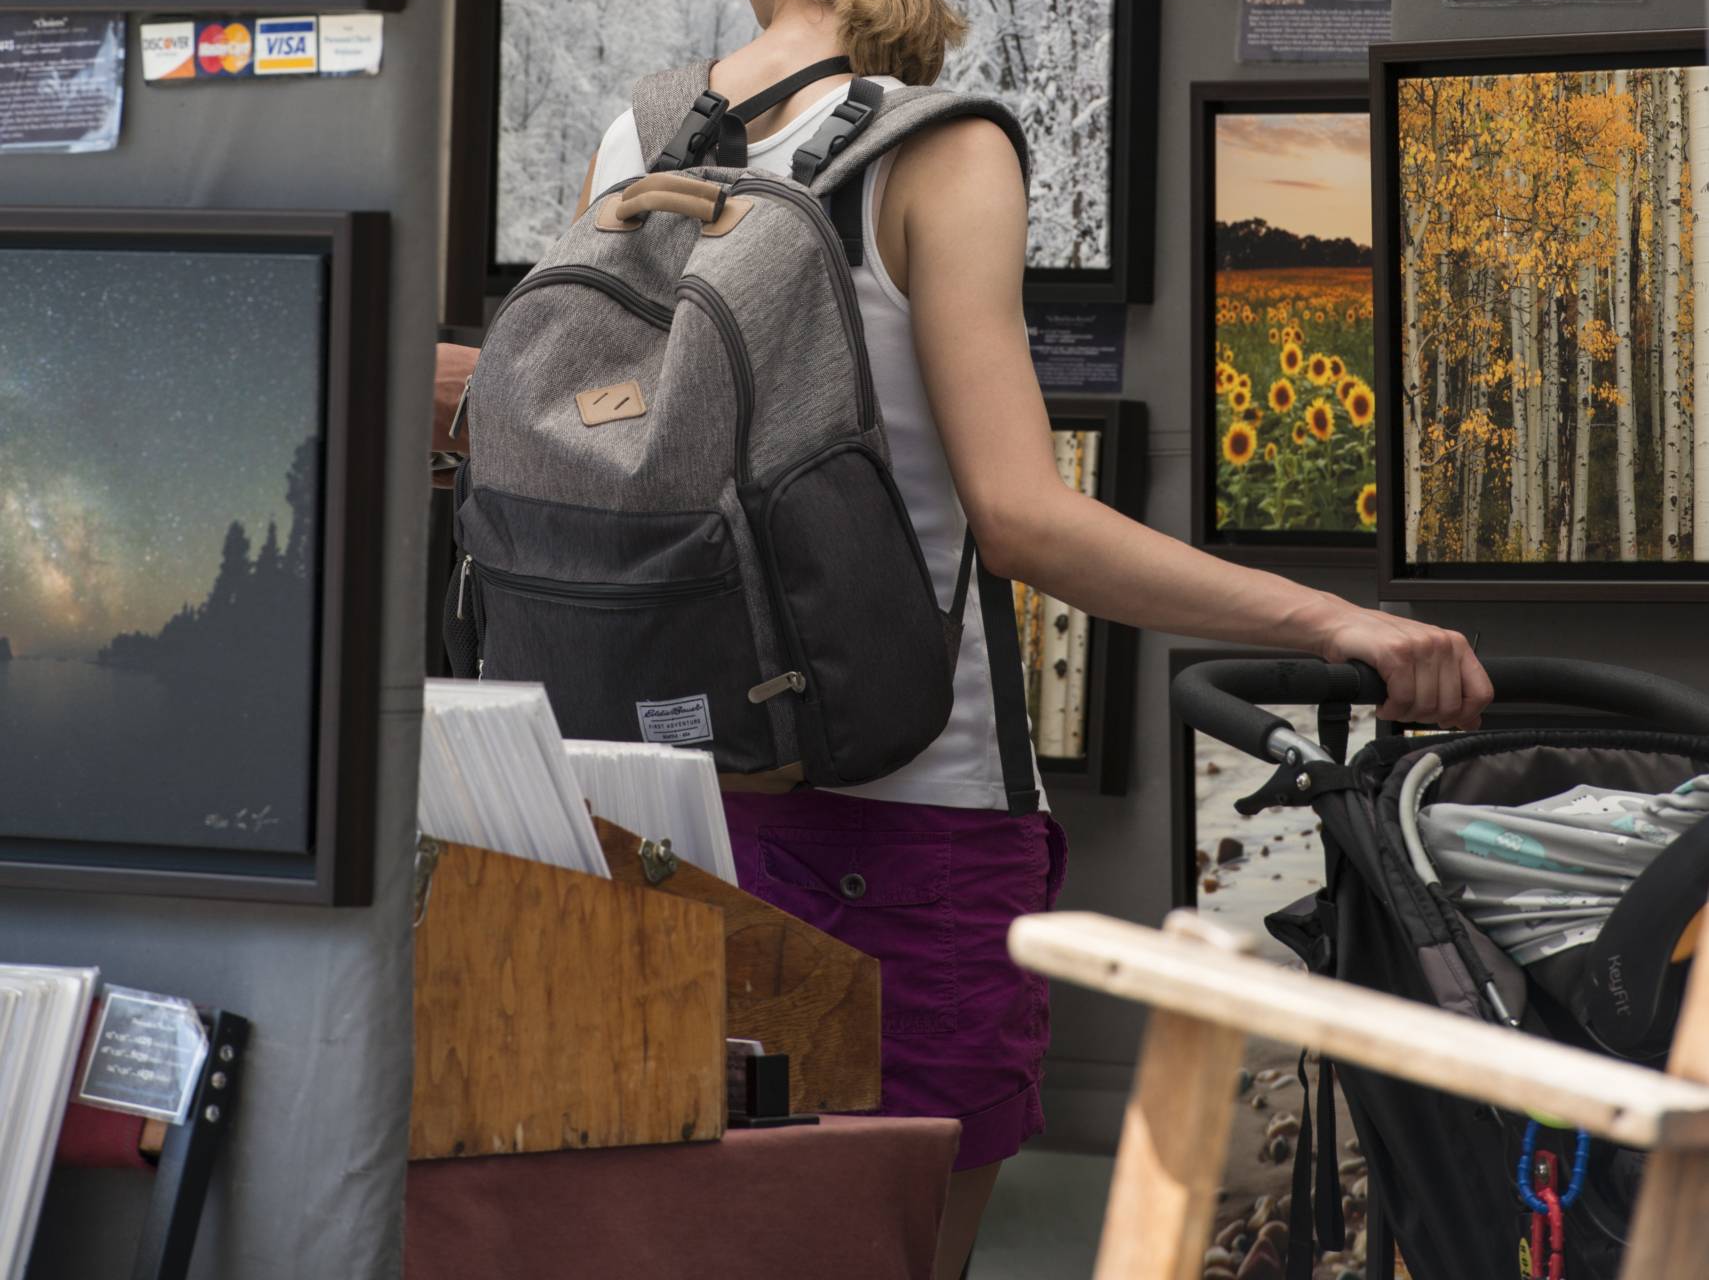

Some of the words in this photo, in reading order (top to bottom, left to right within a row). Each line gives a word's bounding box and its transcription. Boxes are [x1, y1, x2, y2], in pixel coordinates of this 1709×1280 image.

[266, 35, 306, 56] VISA
[666, 718, 702, 729] ADVENTURE
[1607, 954, 1630, 1017] KeyFit
